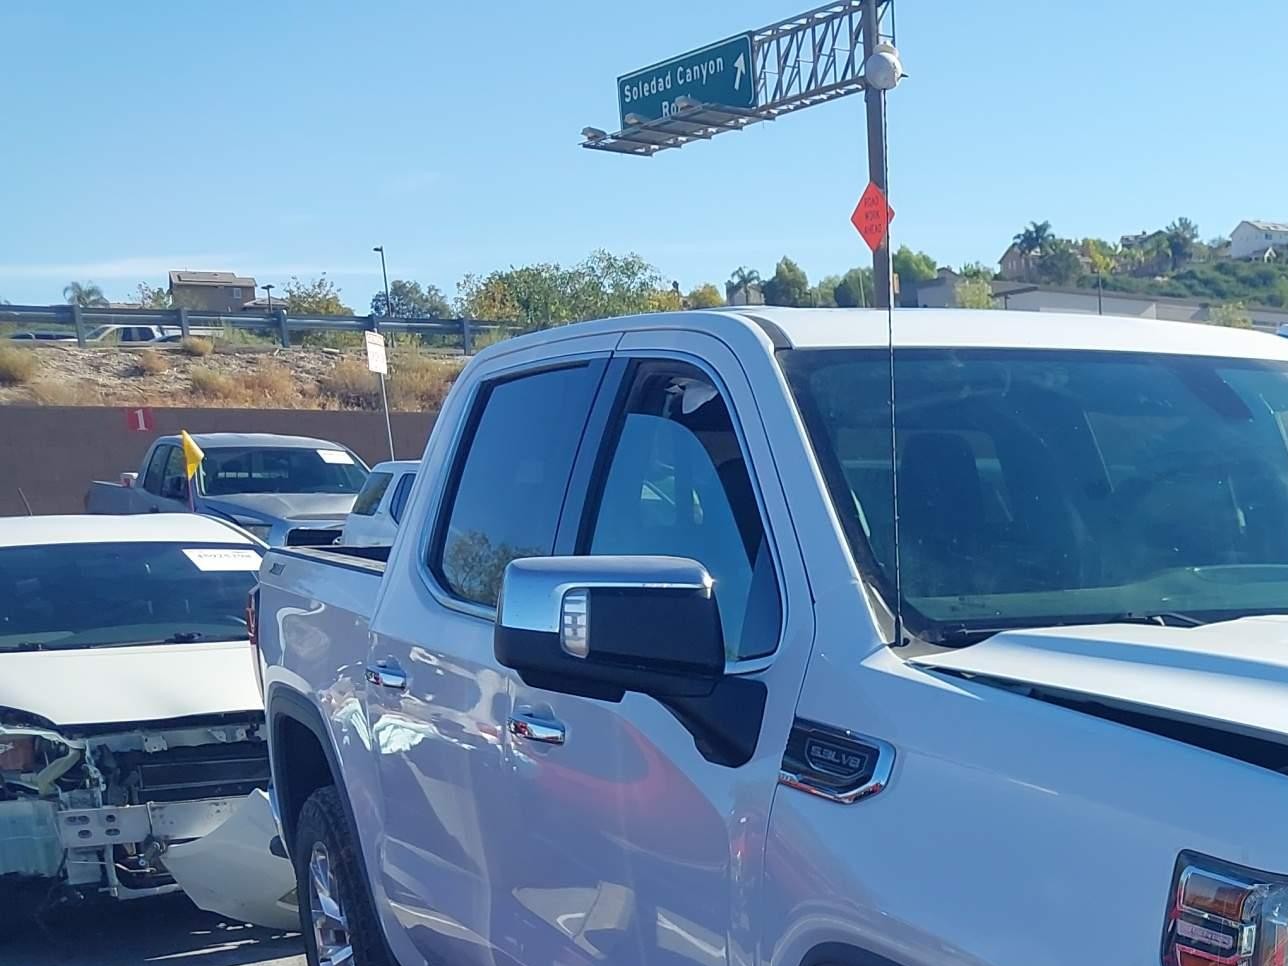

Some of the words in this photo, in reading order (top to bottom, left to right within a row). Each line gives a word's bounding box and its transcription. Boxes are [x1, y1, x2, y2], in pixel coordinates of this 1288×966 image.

[624, 72, 672, 102] Soledad
[677, 57, 724, 85] Canyon
[134, 409, 149, 431] 1
